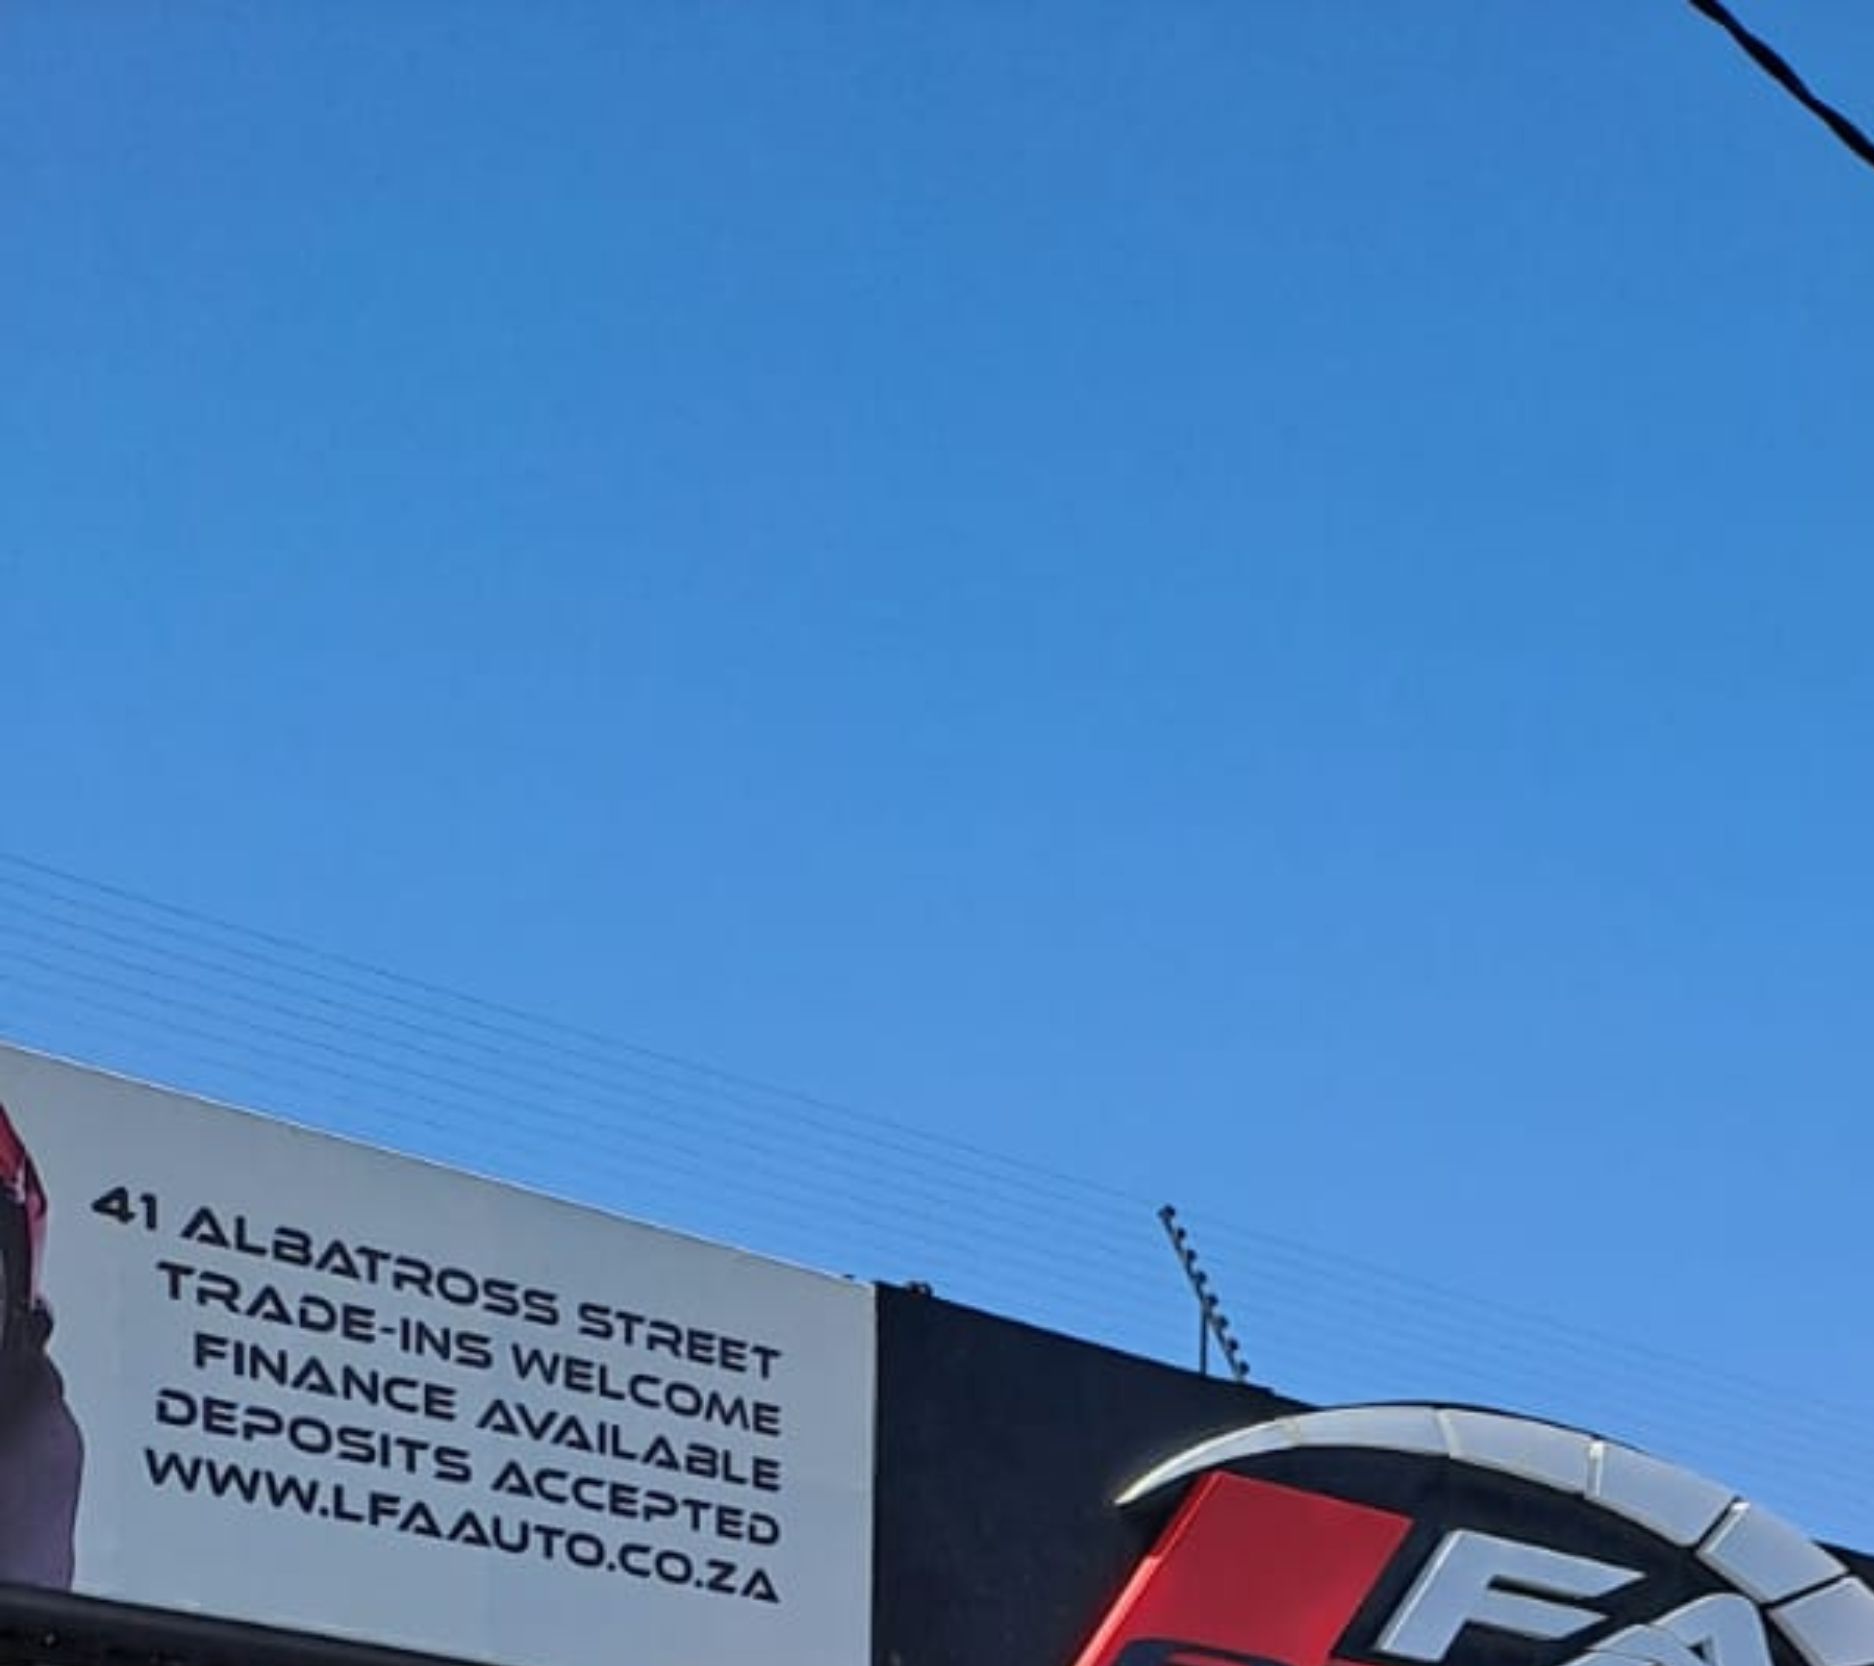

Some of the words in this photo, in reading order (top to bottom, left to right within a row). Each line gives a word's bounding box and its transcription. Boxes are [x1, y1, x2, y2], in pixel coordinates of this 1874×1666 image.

[91, 1186, 156, 1230] 41
[181, 1207, 560, 1326] ALBATROSS
[578, 1306, 781, 1380] STREET
[156, 1262, 492, 1369] TRADE-INS
[512, 1343, 781, 1436] WELCOME
[156, 1390, 471, 1484] DEPOSITS
[491, 1462, 781, 1546] ACCEPTED
[195, 1333, 457, 1421] FINANCE
[476, 1399, 781, 1492] AVAILABLE
[143, 1448, 781, 1604] WWW.LFAAUTO.CO.ZA
